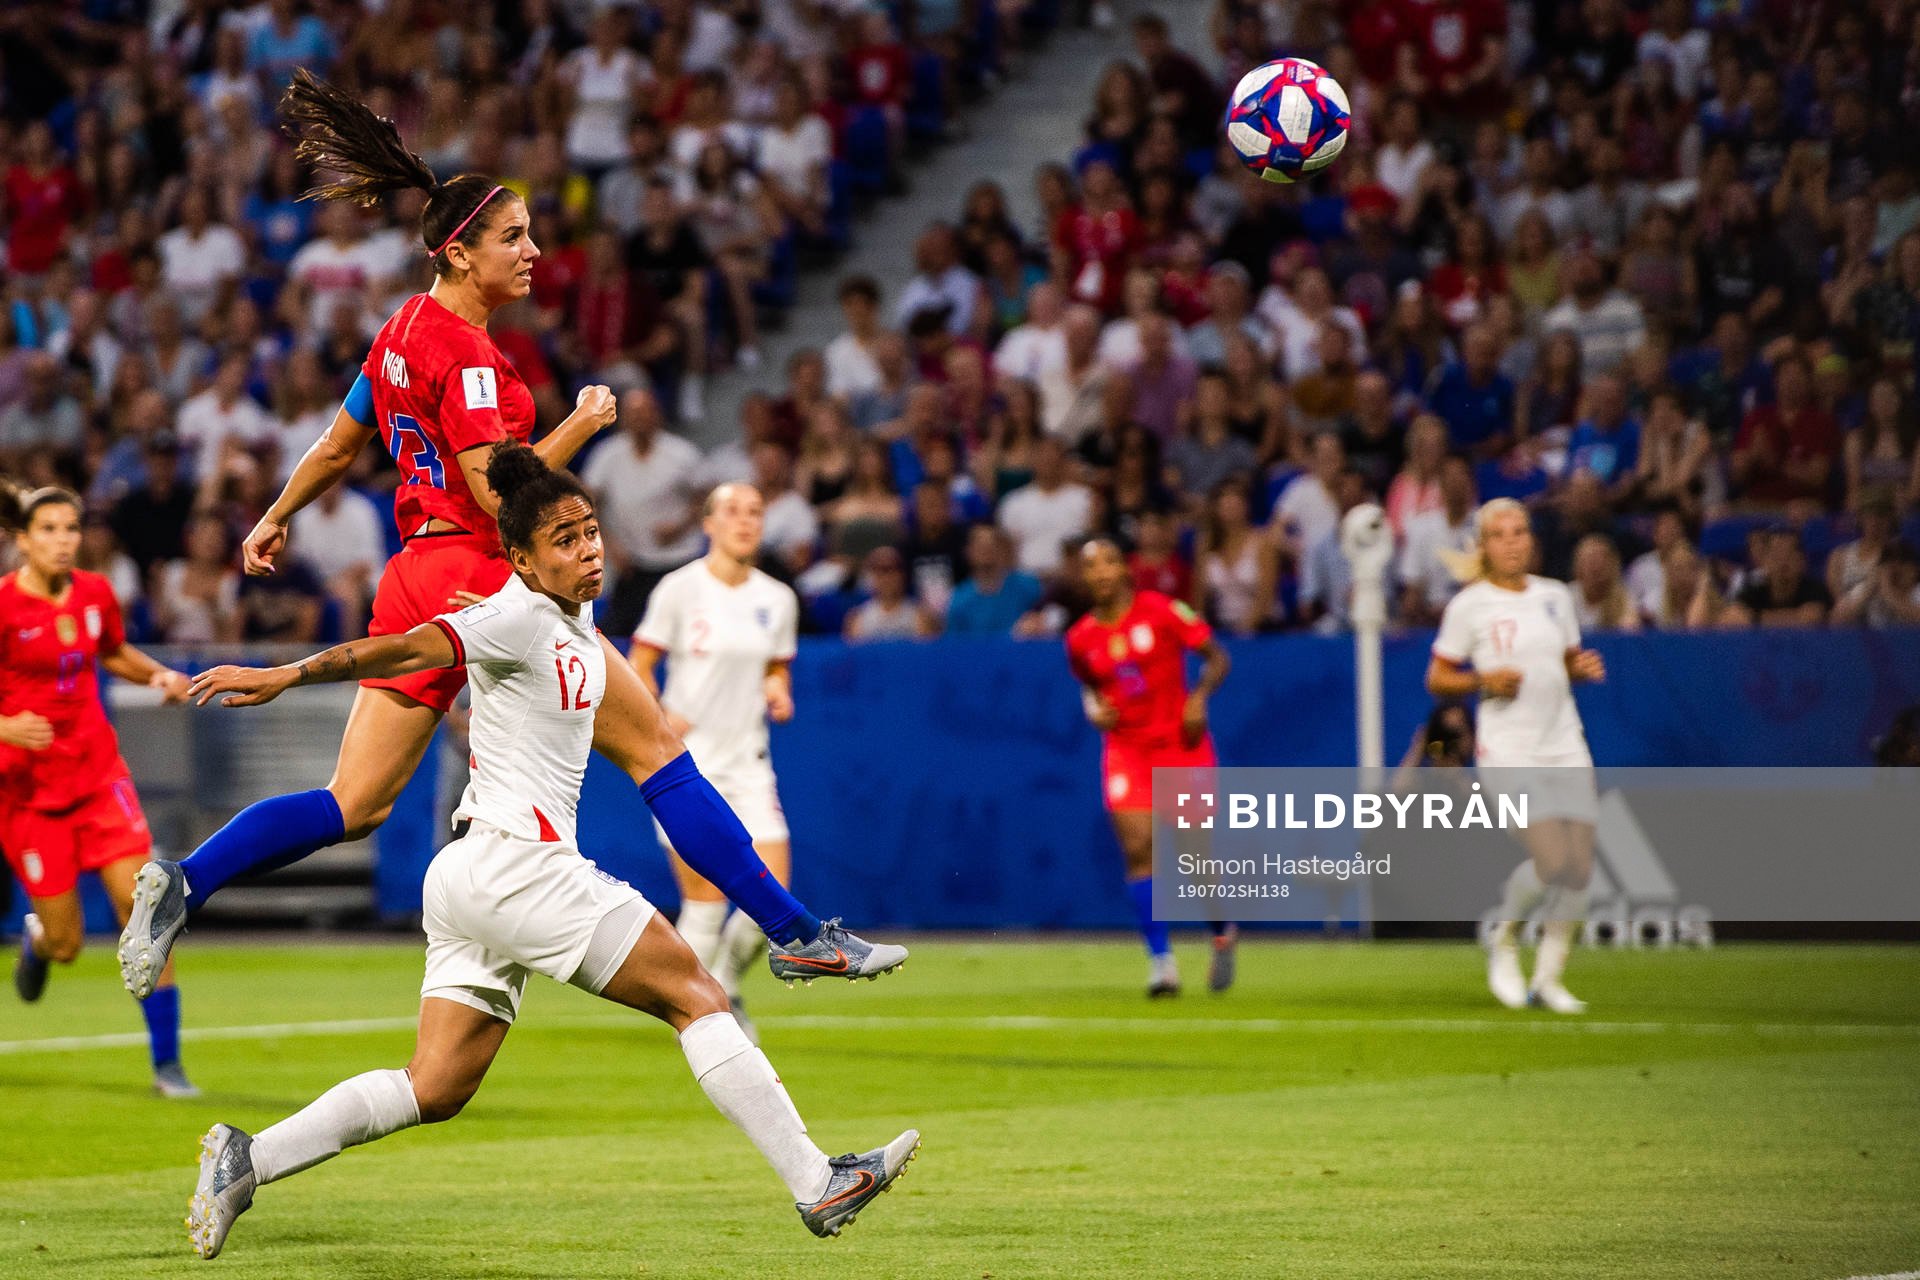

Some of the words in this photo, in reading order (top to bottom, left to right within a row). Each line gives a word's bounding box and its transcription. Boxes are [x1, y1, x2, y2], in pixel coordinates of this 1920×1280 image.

[690, 619, 711, 658] 2
[1492, 618, 1518, 656] 17
[555, 655, 591, 711] 12
